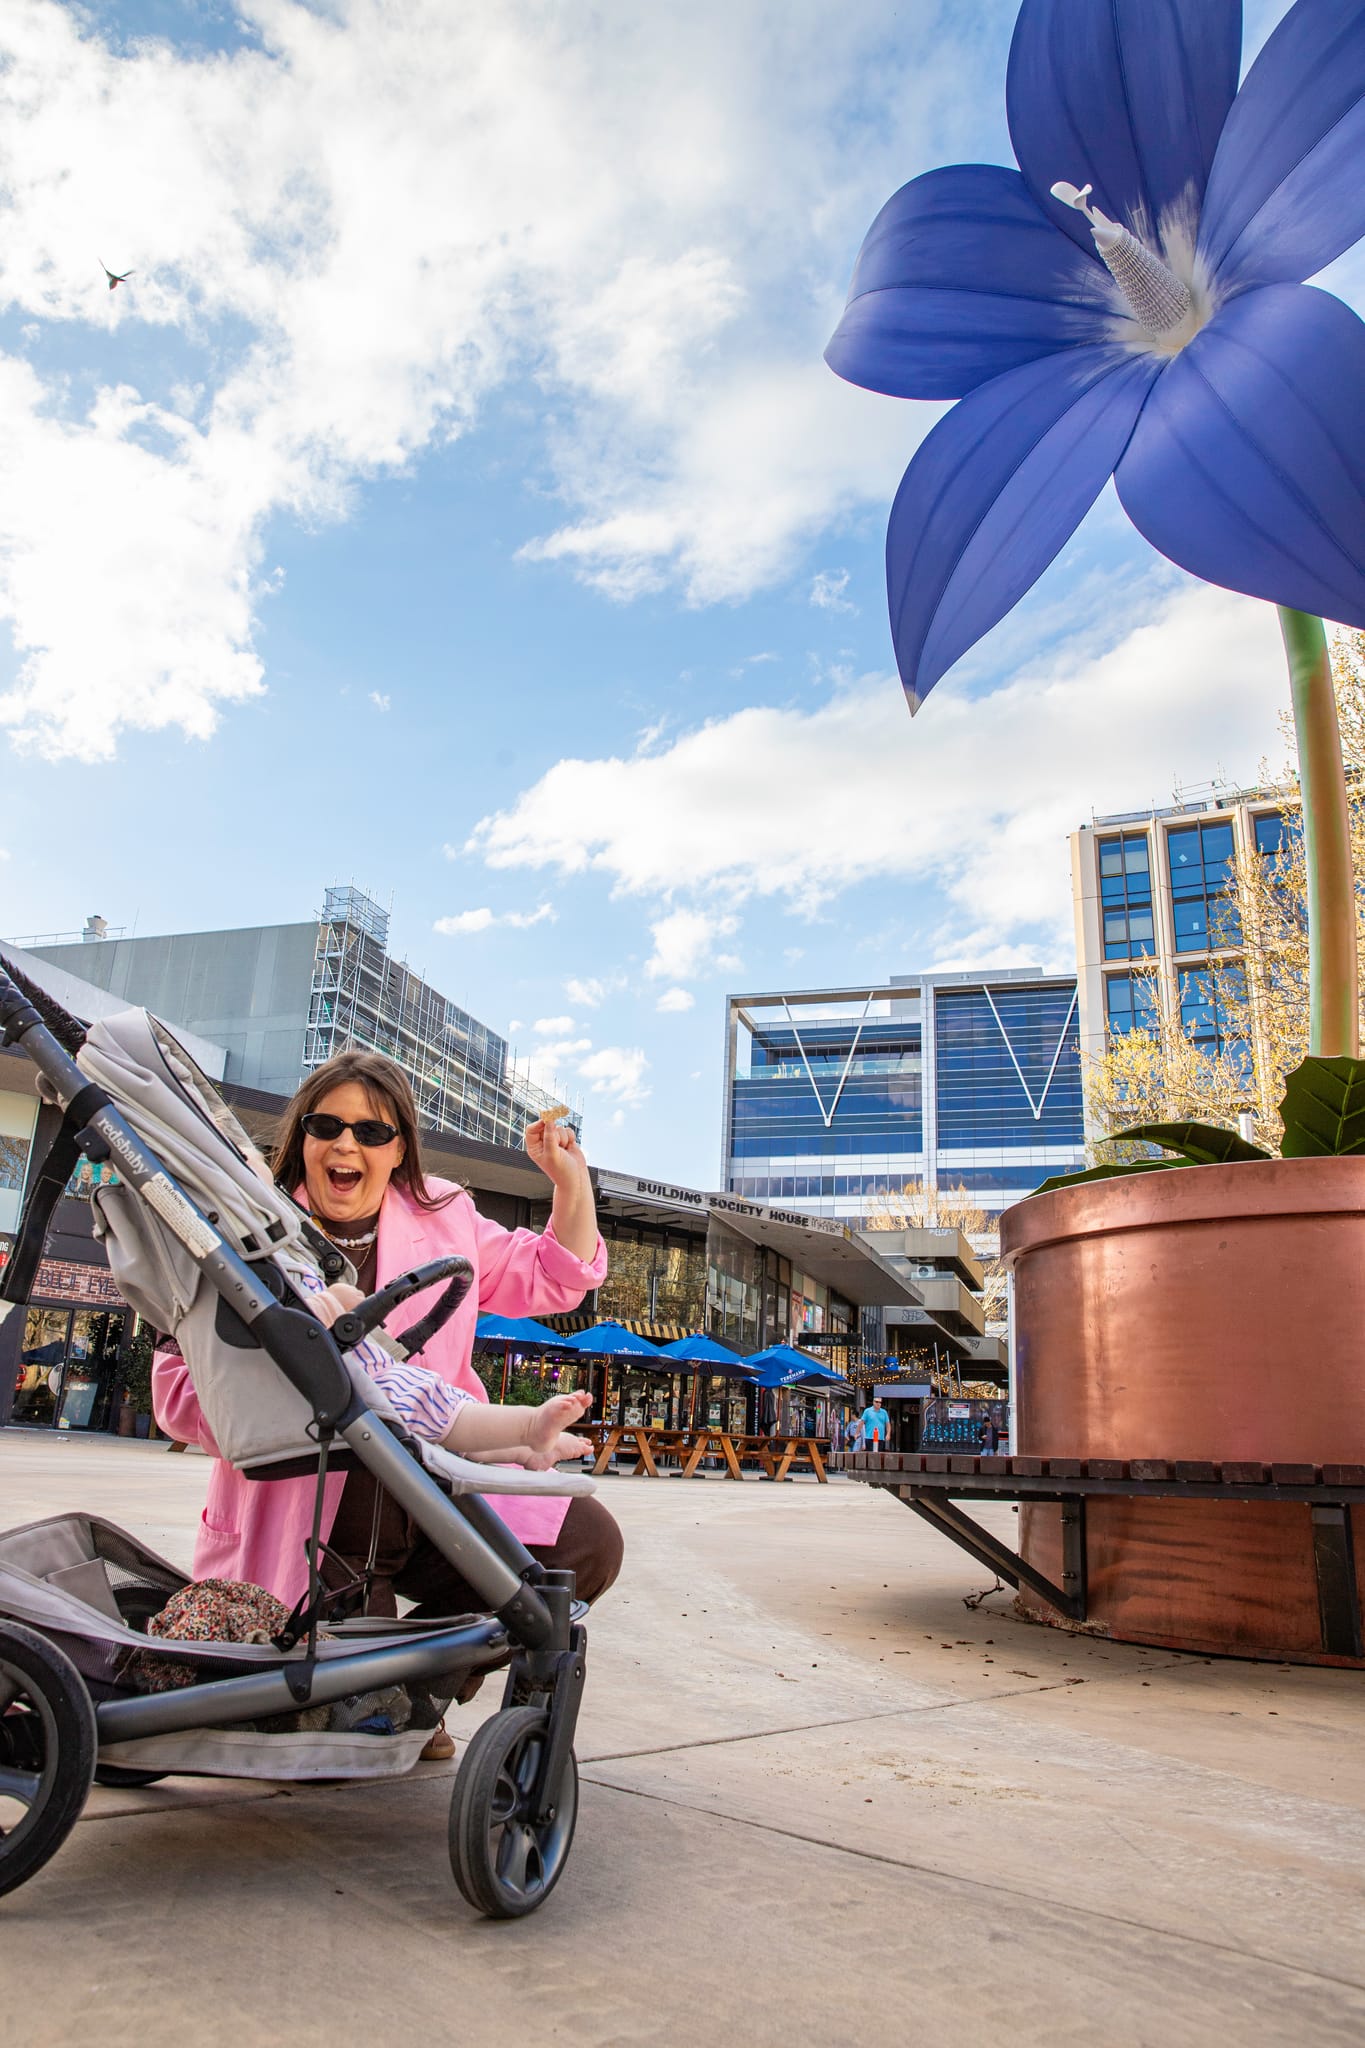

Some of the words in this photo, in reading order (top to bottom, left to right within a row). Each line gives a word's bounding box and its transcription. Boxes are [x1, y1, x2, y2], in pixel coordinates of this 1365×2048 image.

[97, 1117, 149, 1175] redsbaby
[162, 1183, 186, 1210] WARNING
[637, 1180, 703, 1204] BUILDING
[709, 1197, 764, 1217] SOCIETY
[769, 1210, 809, 1227] HOUSE
